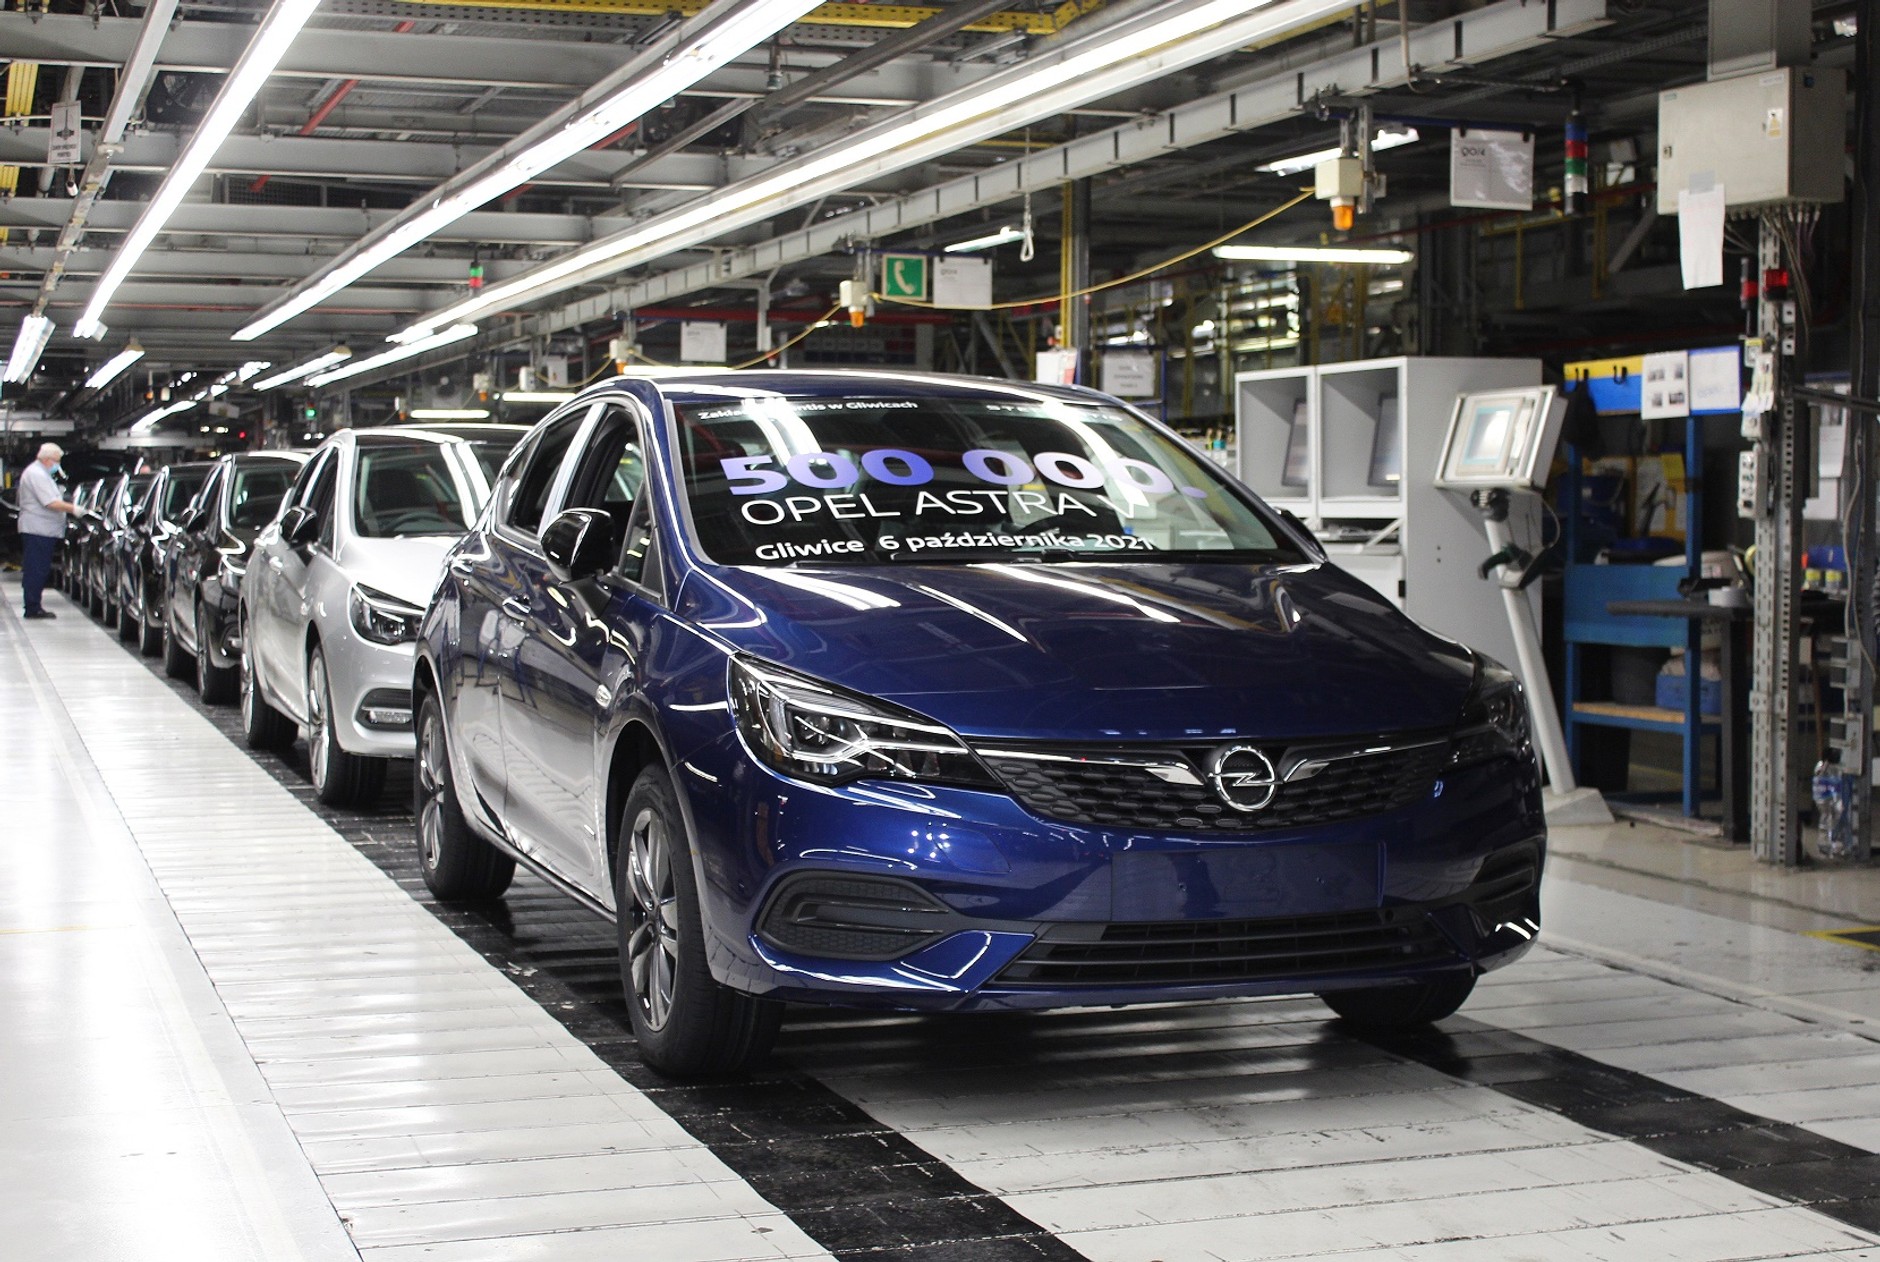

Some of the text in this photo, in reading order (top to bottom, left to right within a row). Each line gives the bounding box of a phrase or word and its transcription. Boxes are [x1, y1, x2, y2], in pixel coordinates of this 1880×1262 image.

[846, 401, 918, 410] Gliwicach
[719, 449, 935, 496] 500
[741, 493, 901, 525] OPEL
[915, 490, 1098, 517] ASTRA
[755, 532, 1154, 560] Gliwice 6 października 2021
